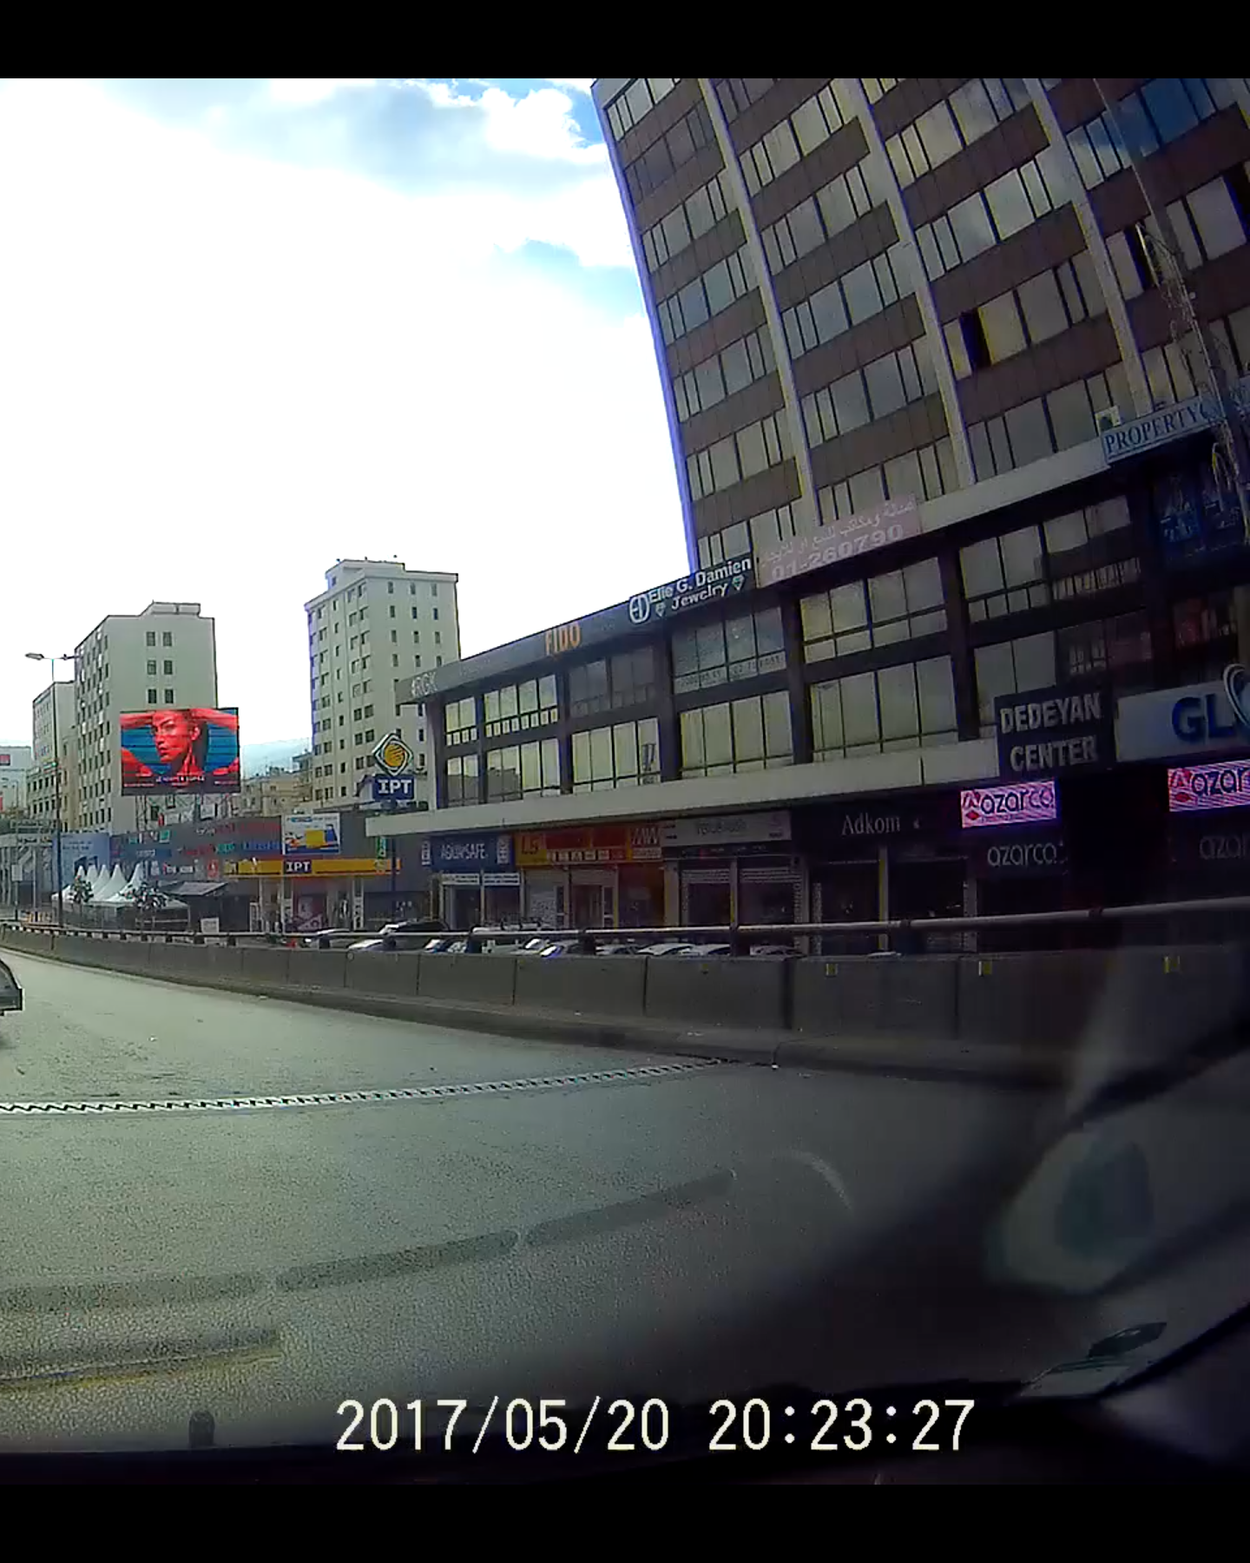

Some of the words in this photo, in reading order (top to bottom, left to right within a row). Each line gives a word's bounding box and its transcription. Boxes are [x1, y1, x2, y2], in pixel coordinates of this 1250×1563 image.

[1104, 404, 1198, 454] PROPERTY
[771, 523, 904, 582] 01-260790
[676, 579, 693, 594] G.
[695, 558, 752, 587] Damien
[671, 583, 728, 611] Jewelry
[1000, 692, 1102, 734] DEDEYAN
[1011, 736, 1097, 771] CENTER
[377, 779, 412, 794] IPT
[840, 811, 901, 838] Adkom
[286, 860, 311, 873] IPT
[987, 842, 1057, 868] azarco
